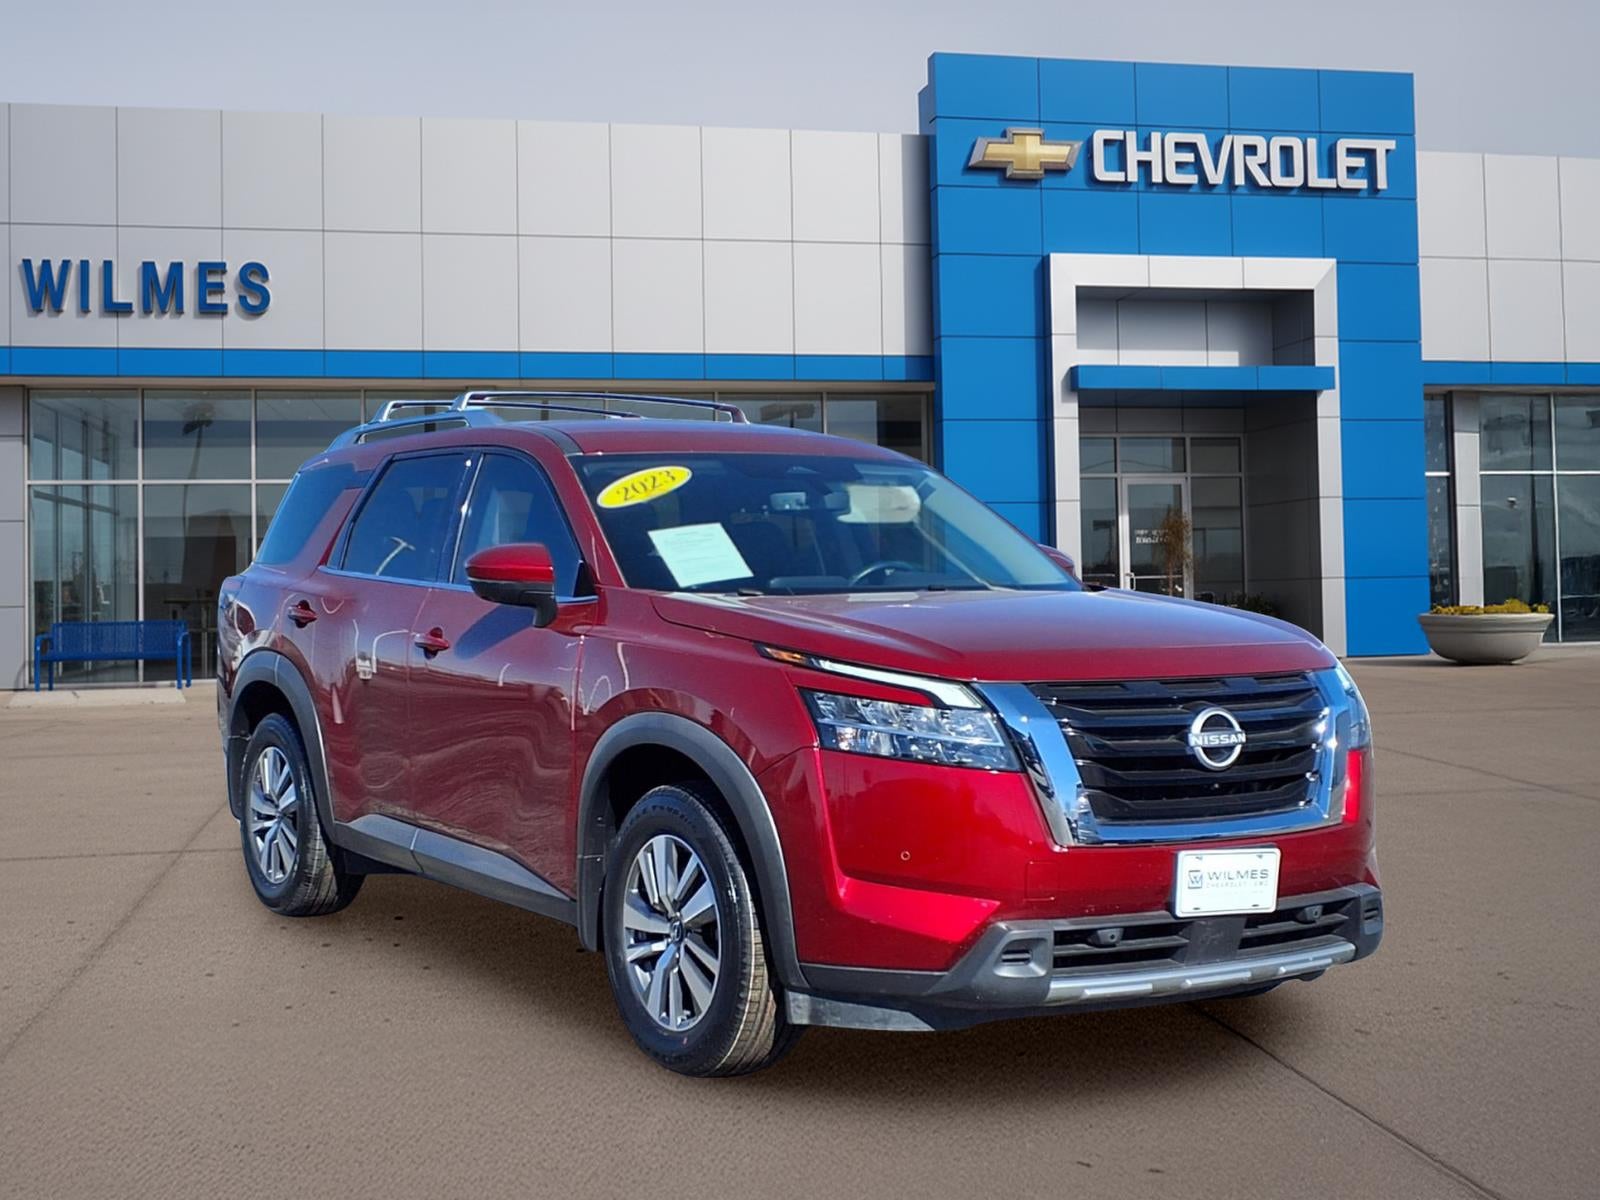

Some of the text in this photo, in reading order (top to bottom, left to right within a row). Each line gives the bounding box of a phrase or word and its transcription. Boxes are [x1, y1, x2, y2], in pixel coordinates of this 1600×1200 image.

[1092, 129, 1397, 190] CHEVROLET
[21, 258, 271, 315] WILMES
[616, 470, 676, 501] 2023
[1190, 732, 1247, 746] NISSAN
[1207, 869, 1269, 881] WILMES
